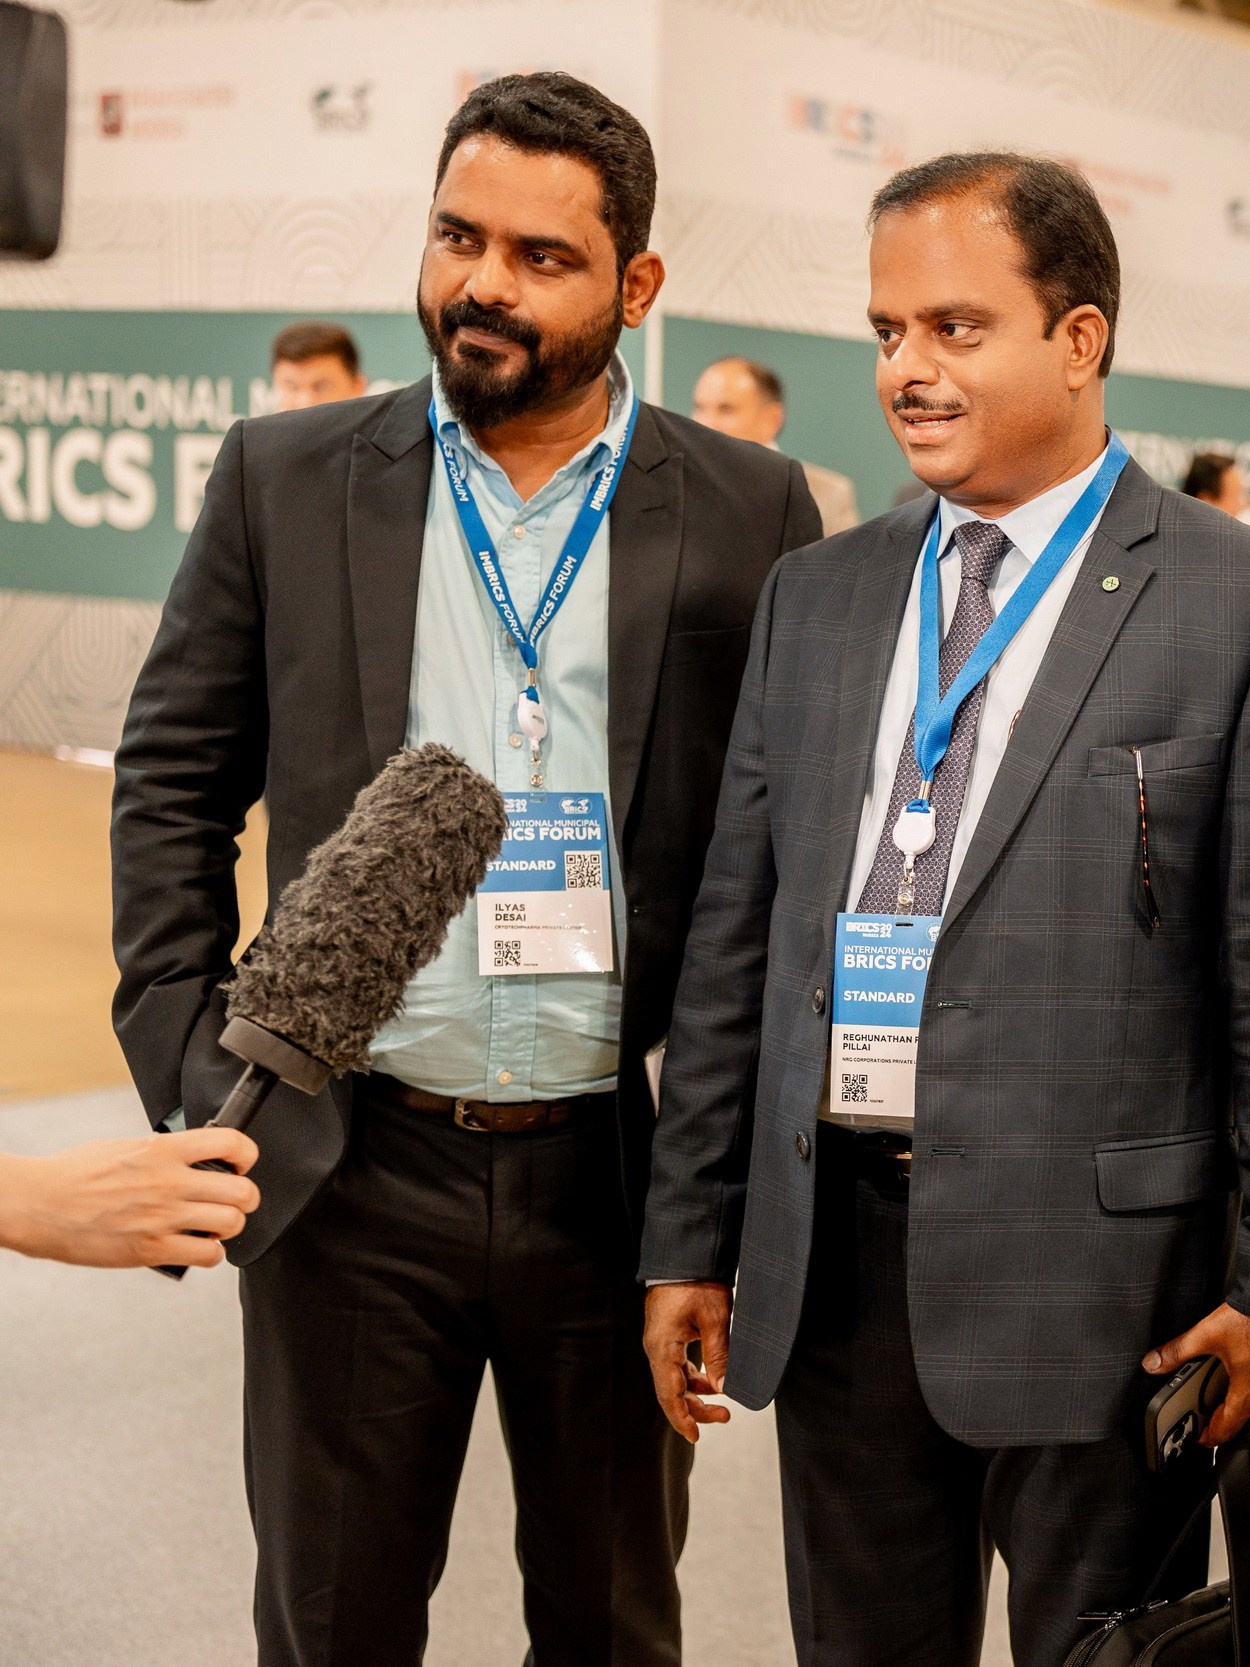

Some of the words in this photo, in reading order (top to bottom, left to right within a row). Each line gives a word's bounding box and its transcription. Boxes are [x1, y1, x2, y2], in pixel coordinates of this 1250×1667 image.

[590, 466, 616, 511] IMBRICS
[479, 550, 505, 602] IMBRICS
[549, 555, 577, 601] FORUM
[507, 819, 553, 828] NATIONAL
[554, 819, 600, 828] MUNICIPAL
[539, 827, 601, 841] FORUM
[486, 860, 556, 872] STANDARD
[495, 904, 526, 912] ILYAS
[495, 913, 526, 921] DESAI
[844, 945, 917, 956] INTERNATIONAL
[843, 953, 897, 970] BRICS
[843, 990, 915, 1004] STANDARD
[843, 1033, 913, 1044] REGHUNATHAN
[842, 1043, 871, 1051] PILLAI
